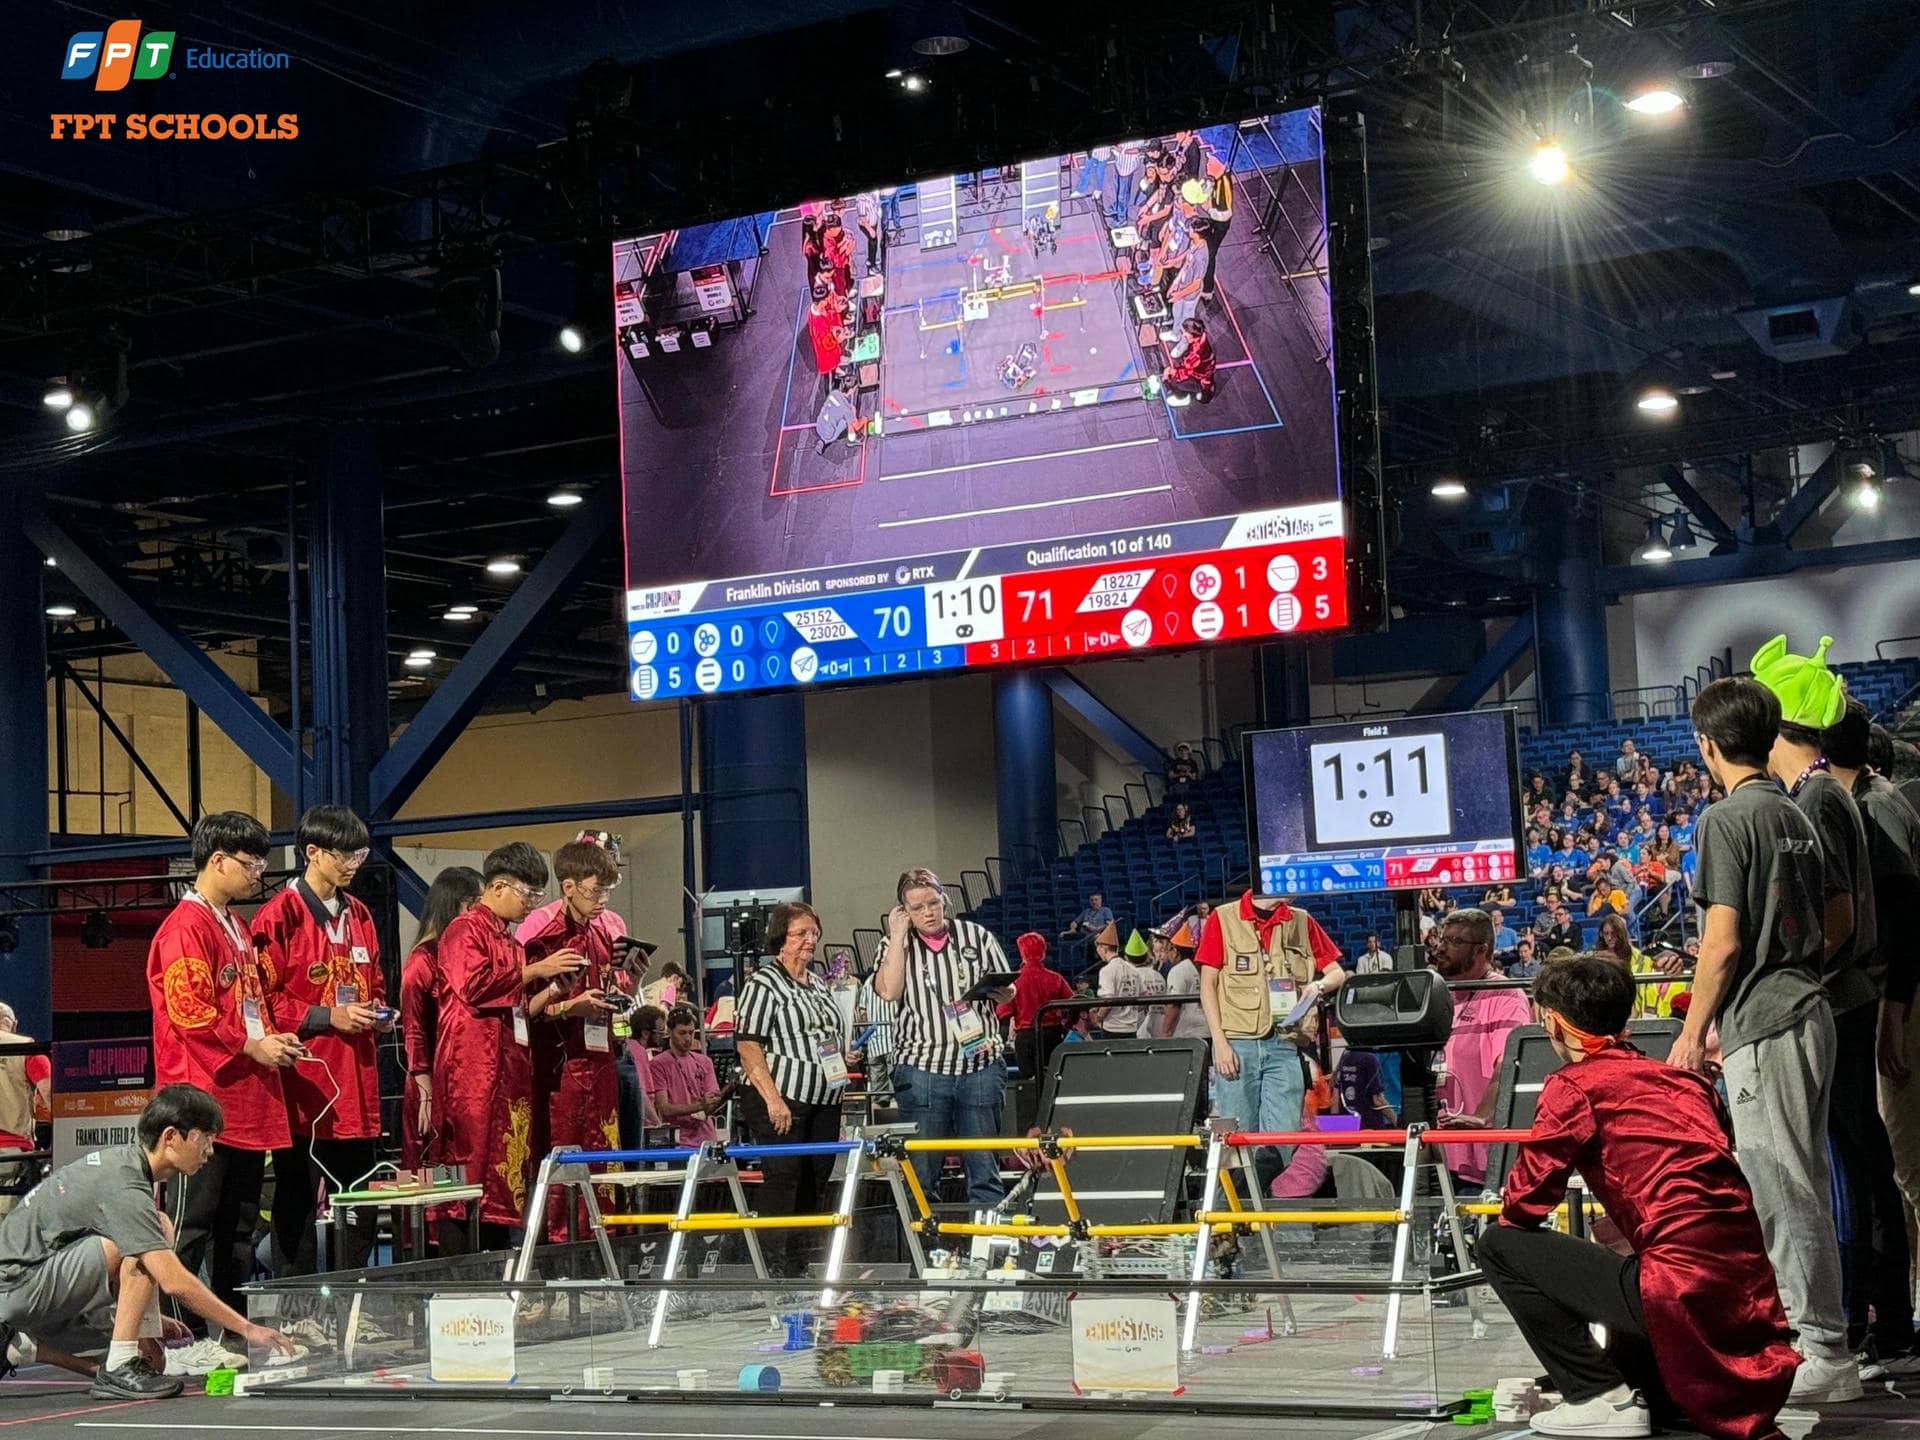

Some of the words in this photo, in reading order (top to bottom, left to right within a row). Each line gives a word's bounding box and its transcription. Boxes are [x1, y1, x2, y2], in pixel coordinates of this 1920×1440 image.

[1027, 543, 1107, 566] Qualification
[1110, 539, 1126, 555] 10
[1129, 536, 1144, 552] of
[1147, 534, 1171, 551] 140
[1312, 556, 1328, 581] 3
[726, 584, 772, 602] Franklin
[774, 579, 820, 596] Division
[825, 575, 876, 590] SPONSORED
[877, 573, 889, 583] BY
[912, 566, 934, 579] RTX
[1103, 573, 1141, 590] 18227
[932, 583, 996, 620] 1:10
[1017, 589, 1052, 623] 71
[1089, 592, 1127, 608] 19824
[1315, 595, 1330, 619] 5
[796, 609, 832, 626] 25152
[873, 606, 912, 638] 70
[731, 625, 743, 647] 0
[810, 624, 846, 640] 23020
[667, 633, 679, 654] 0
[668, 667, 681, 689] 5
[732, 660, 745, 682] 0
[1324, 745, 1428, 801] 1:11
[1366, 865, 1380, 876] 70
[1389, 864, 1403, 875] 71
[76, 1128, 108, 1146] FRANKLIN
[110, 1127, 128, 1144] FIELD
[130, 1126, 136, 1144] 2
